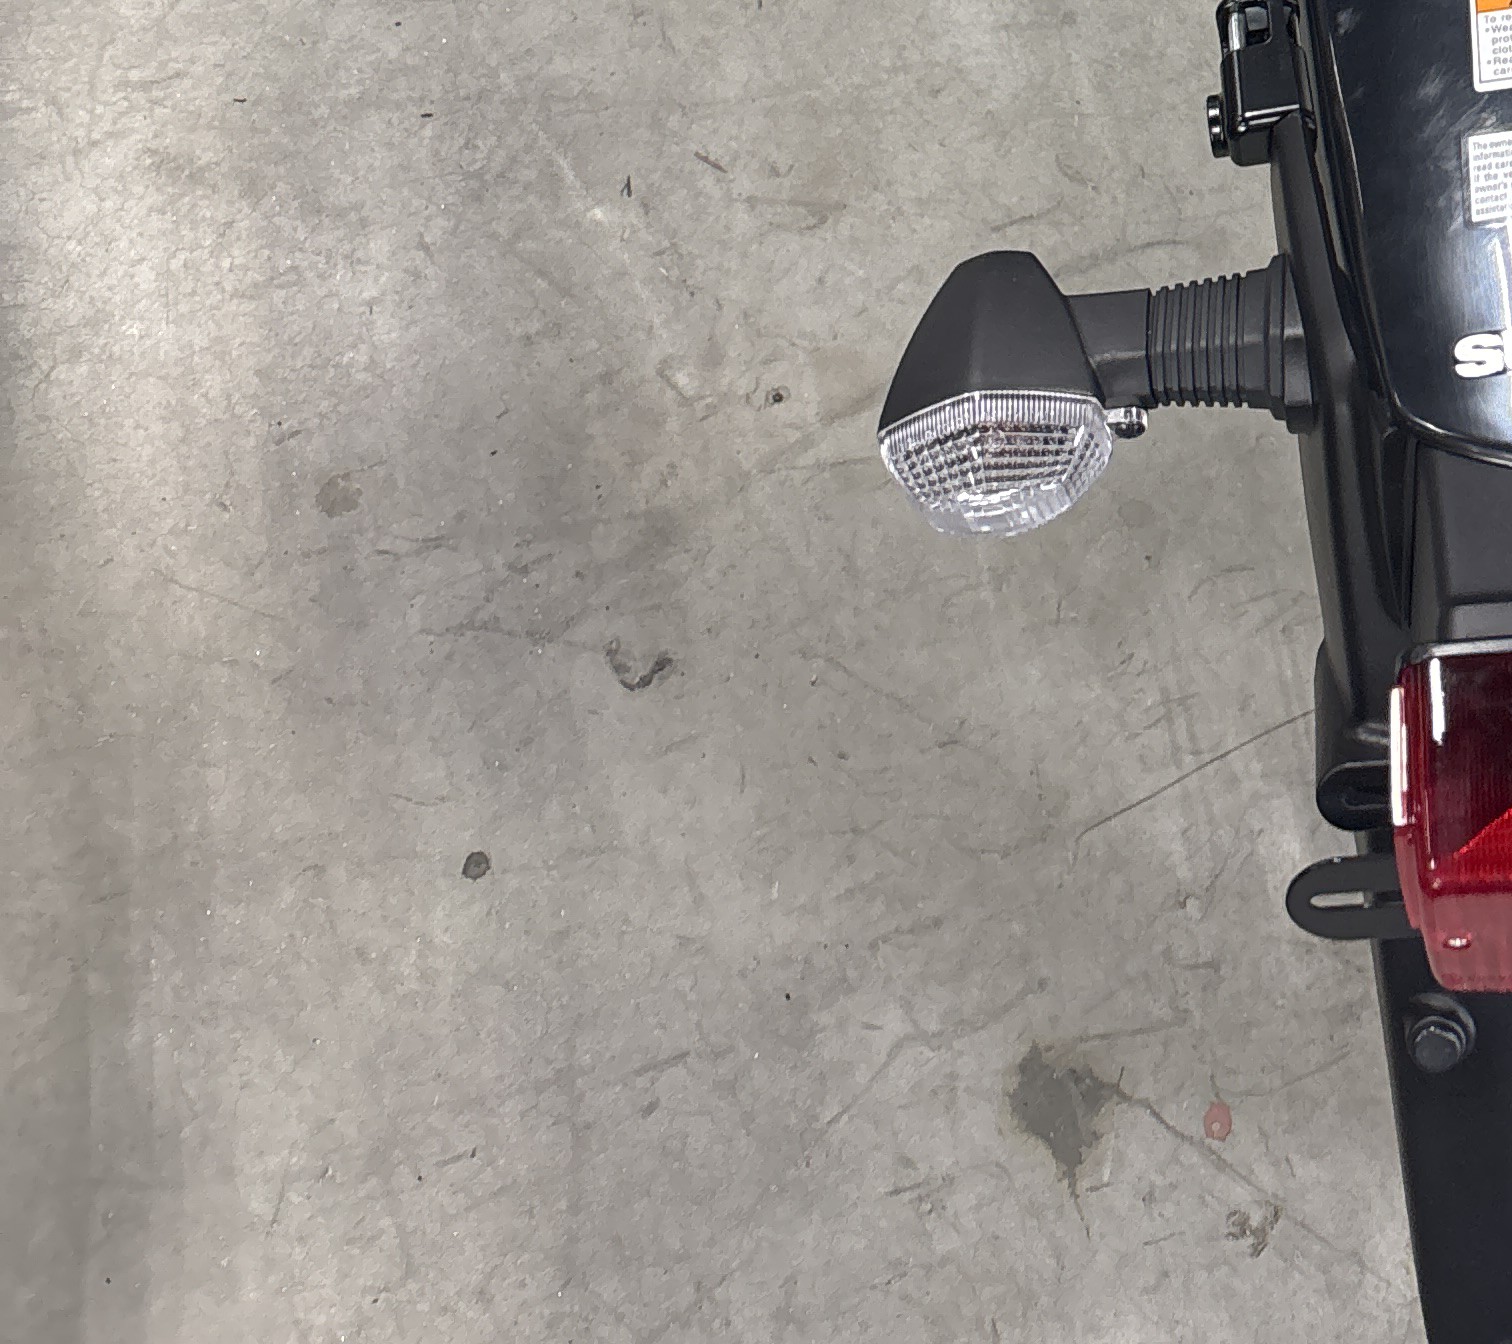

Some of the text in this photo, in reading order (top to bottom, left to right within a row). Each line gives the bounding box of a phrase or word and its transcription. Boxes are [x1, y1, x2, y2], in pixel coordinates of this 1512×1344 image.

[1484, 14, 1497, 25] To
[1473, 141, 1488, 151] The
[1473, 161, 1493, 172] read
[1483, 171, 1499, 182] the
[1474, 180, 1508, 194] owner's
[1474, 192, 1508, 205] contact
